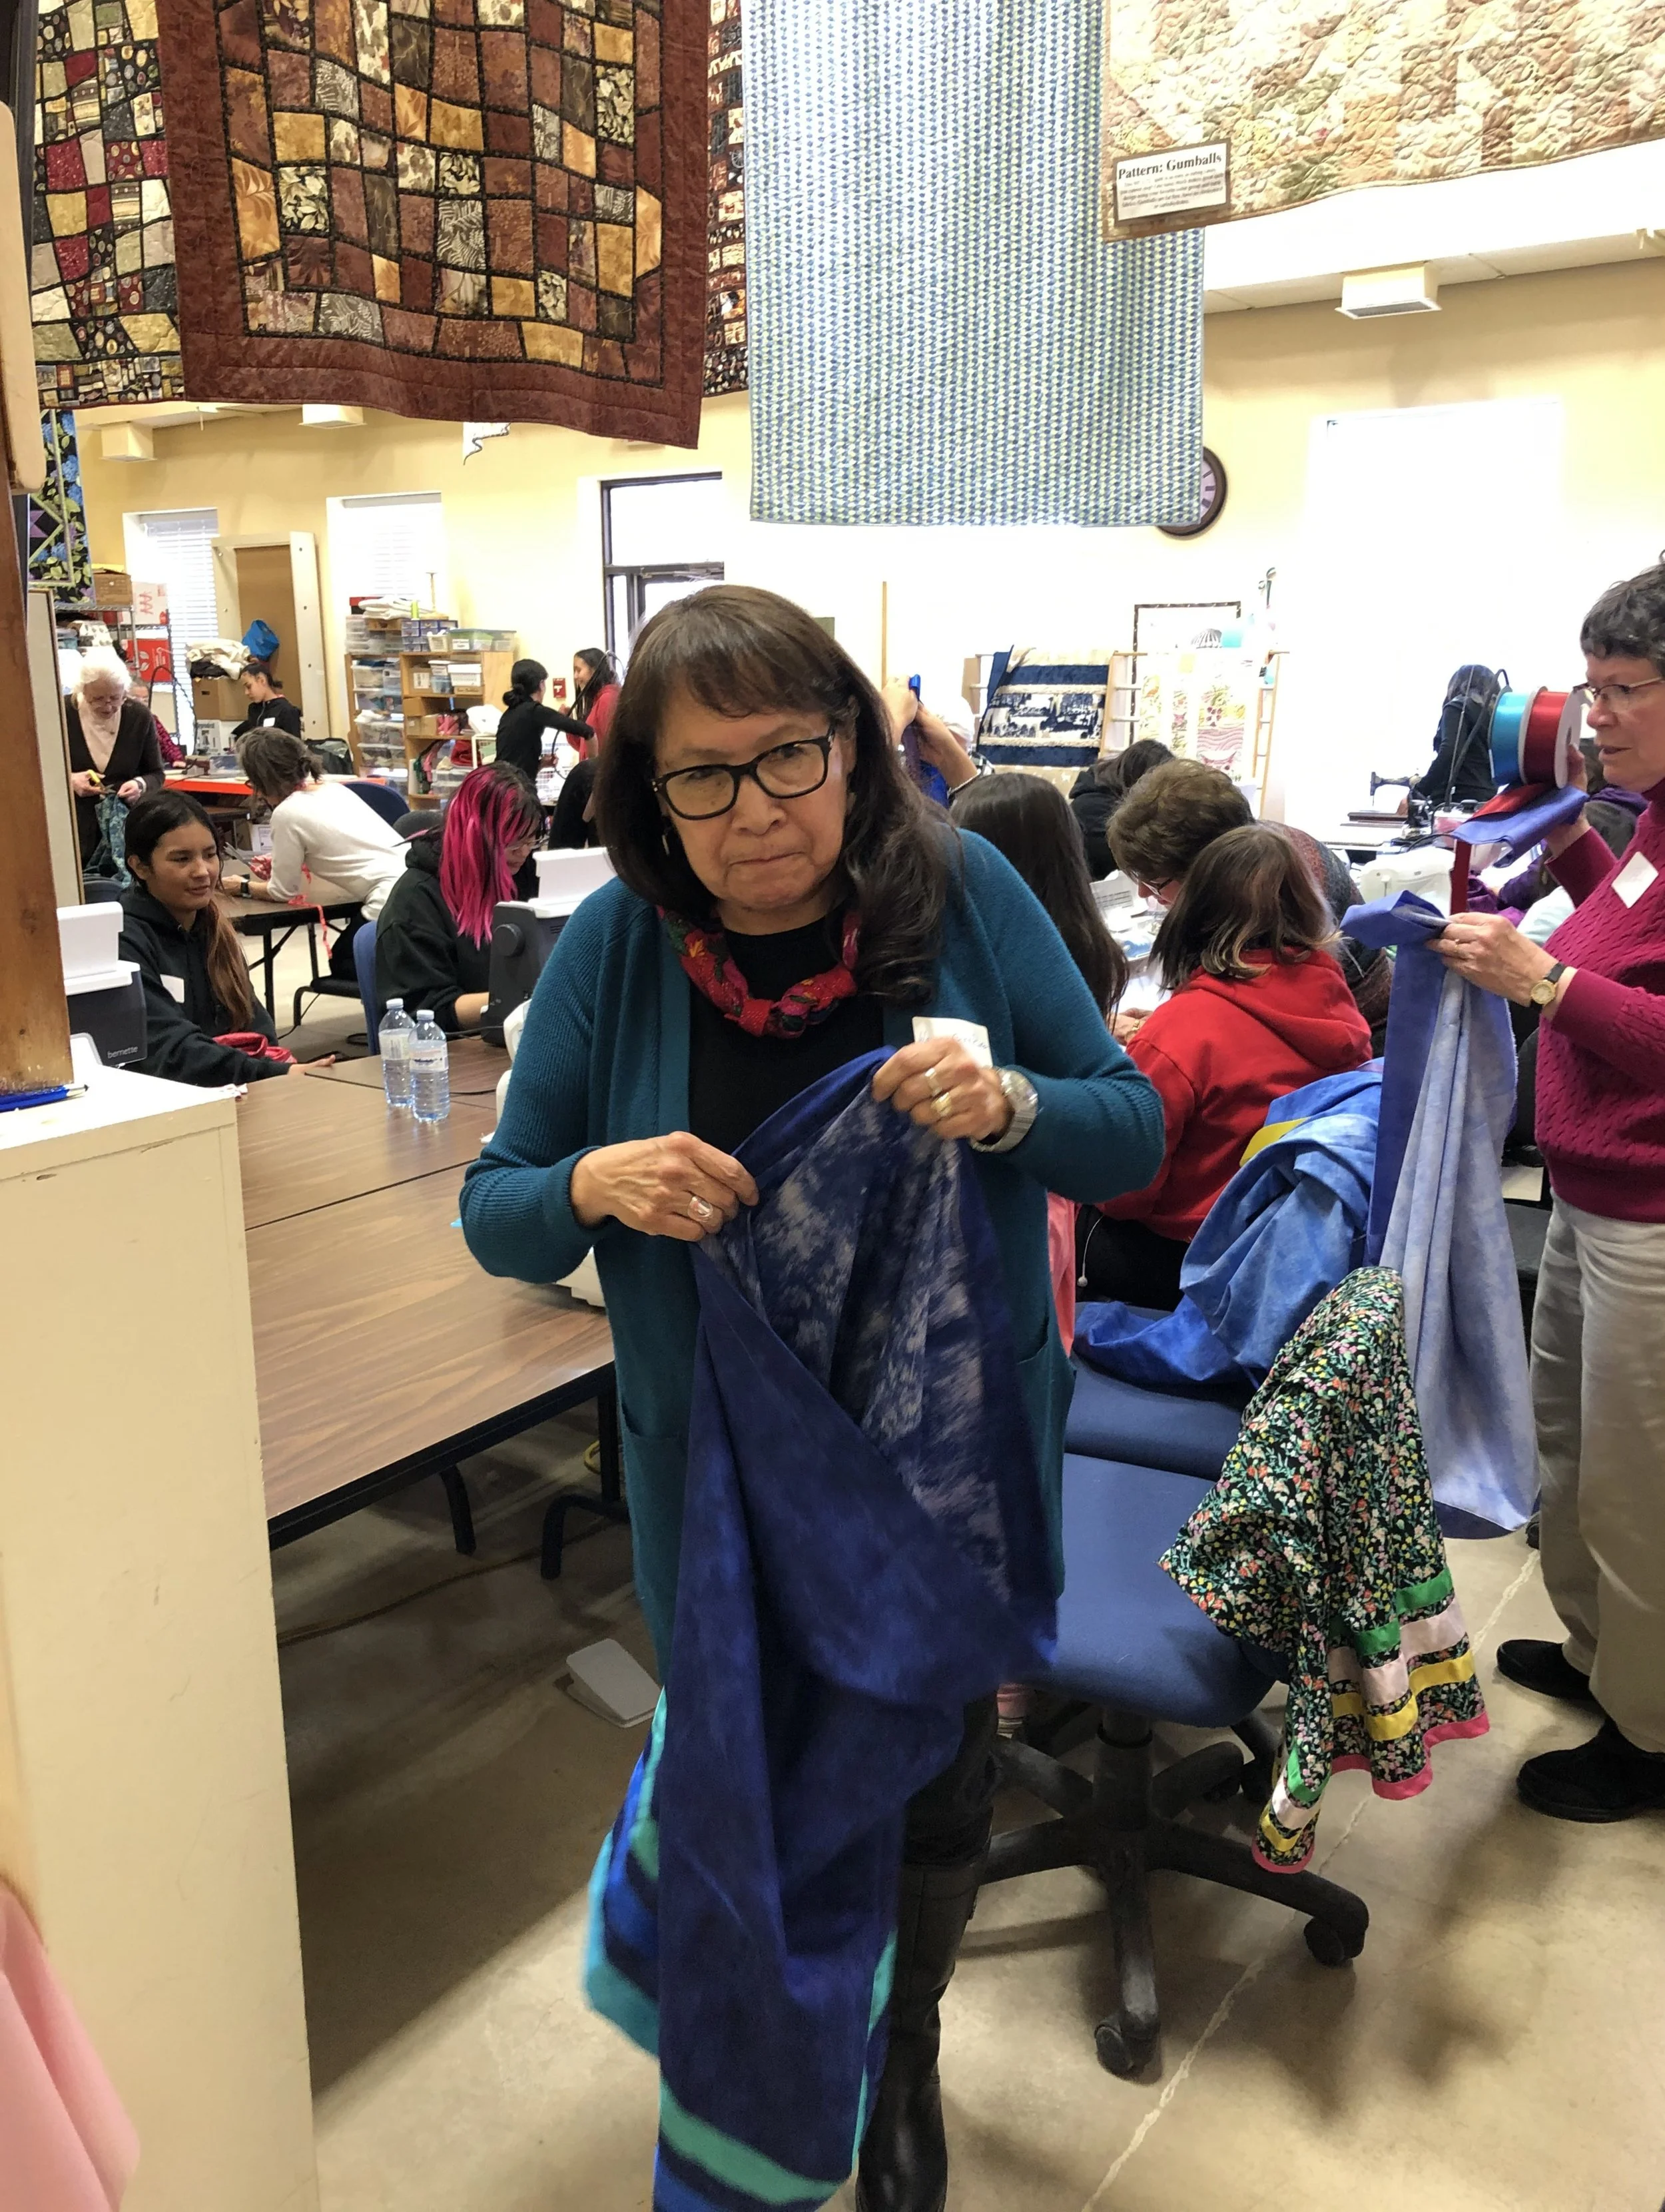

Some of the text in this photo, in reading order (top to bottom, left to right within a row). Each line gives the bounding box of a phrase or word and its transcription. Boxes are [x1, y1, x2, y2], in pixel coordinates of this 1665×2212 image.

[1118, 164, 1163, 180] Pattern:
[1166, 152, 1222, 171] Gumballs
[107, 1046, 139, 1059] bernette
